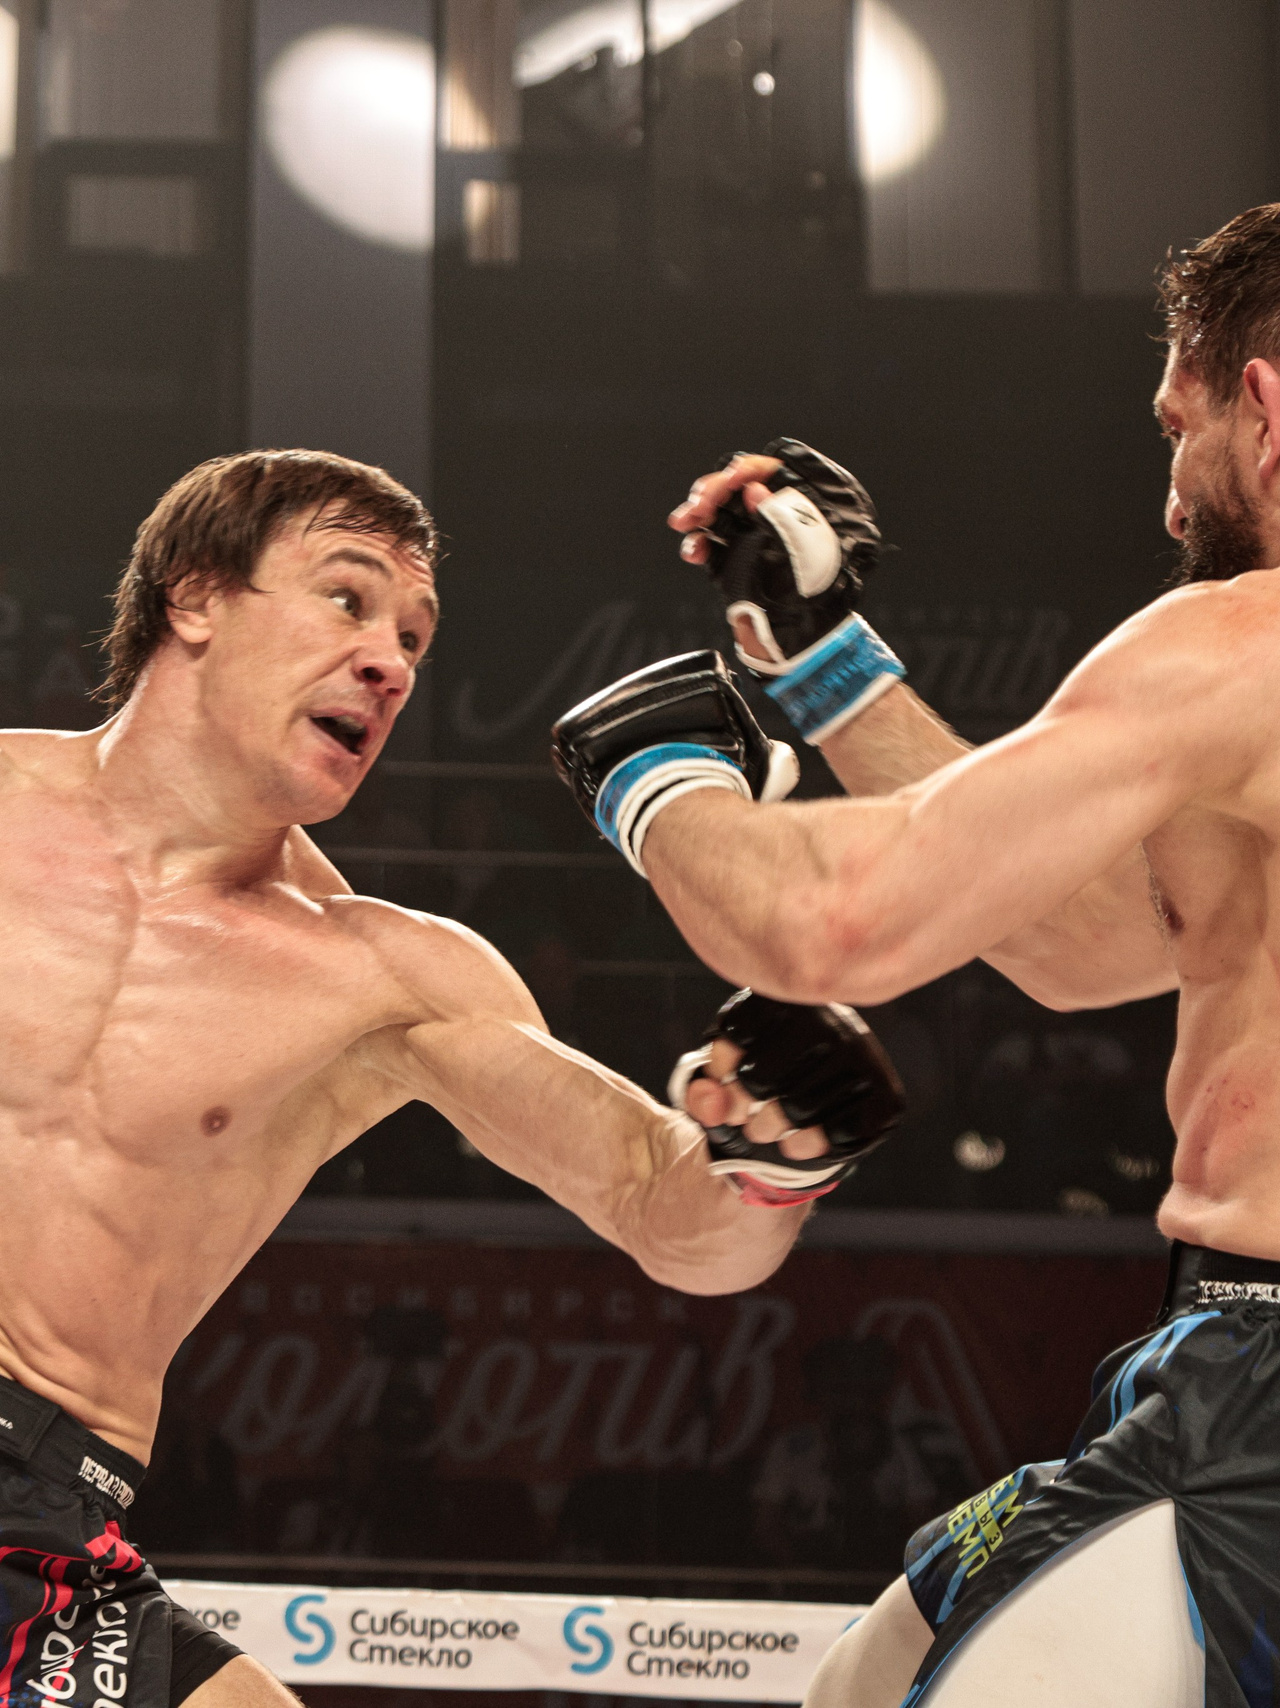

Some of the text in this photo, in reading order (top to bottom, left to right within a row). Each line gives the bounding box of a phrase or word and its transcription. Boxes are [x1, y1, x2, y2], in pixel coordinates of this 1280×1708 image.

[350, 1604, 520, 1643] Сибирское
[628, 1621, 801, 1656] Сибирское
[349, 1638, 473, 1669] Стекло
[627, 1650, 751, 1680] Стекло
